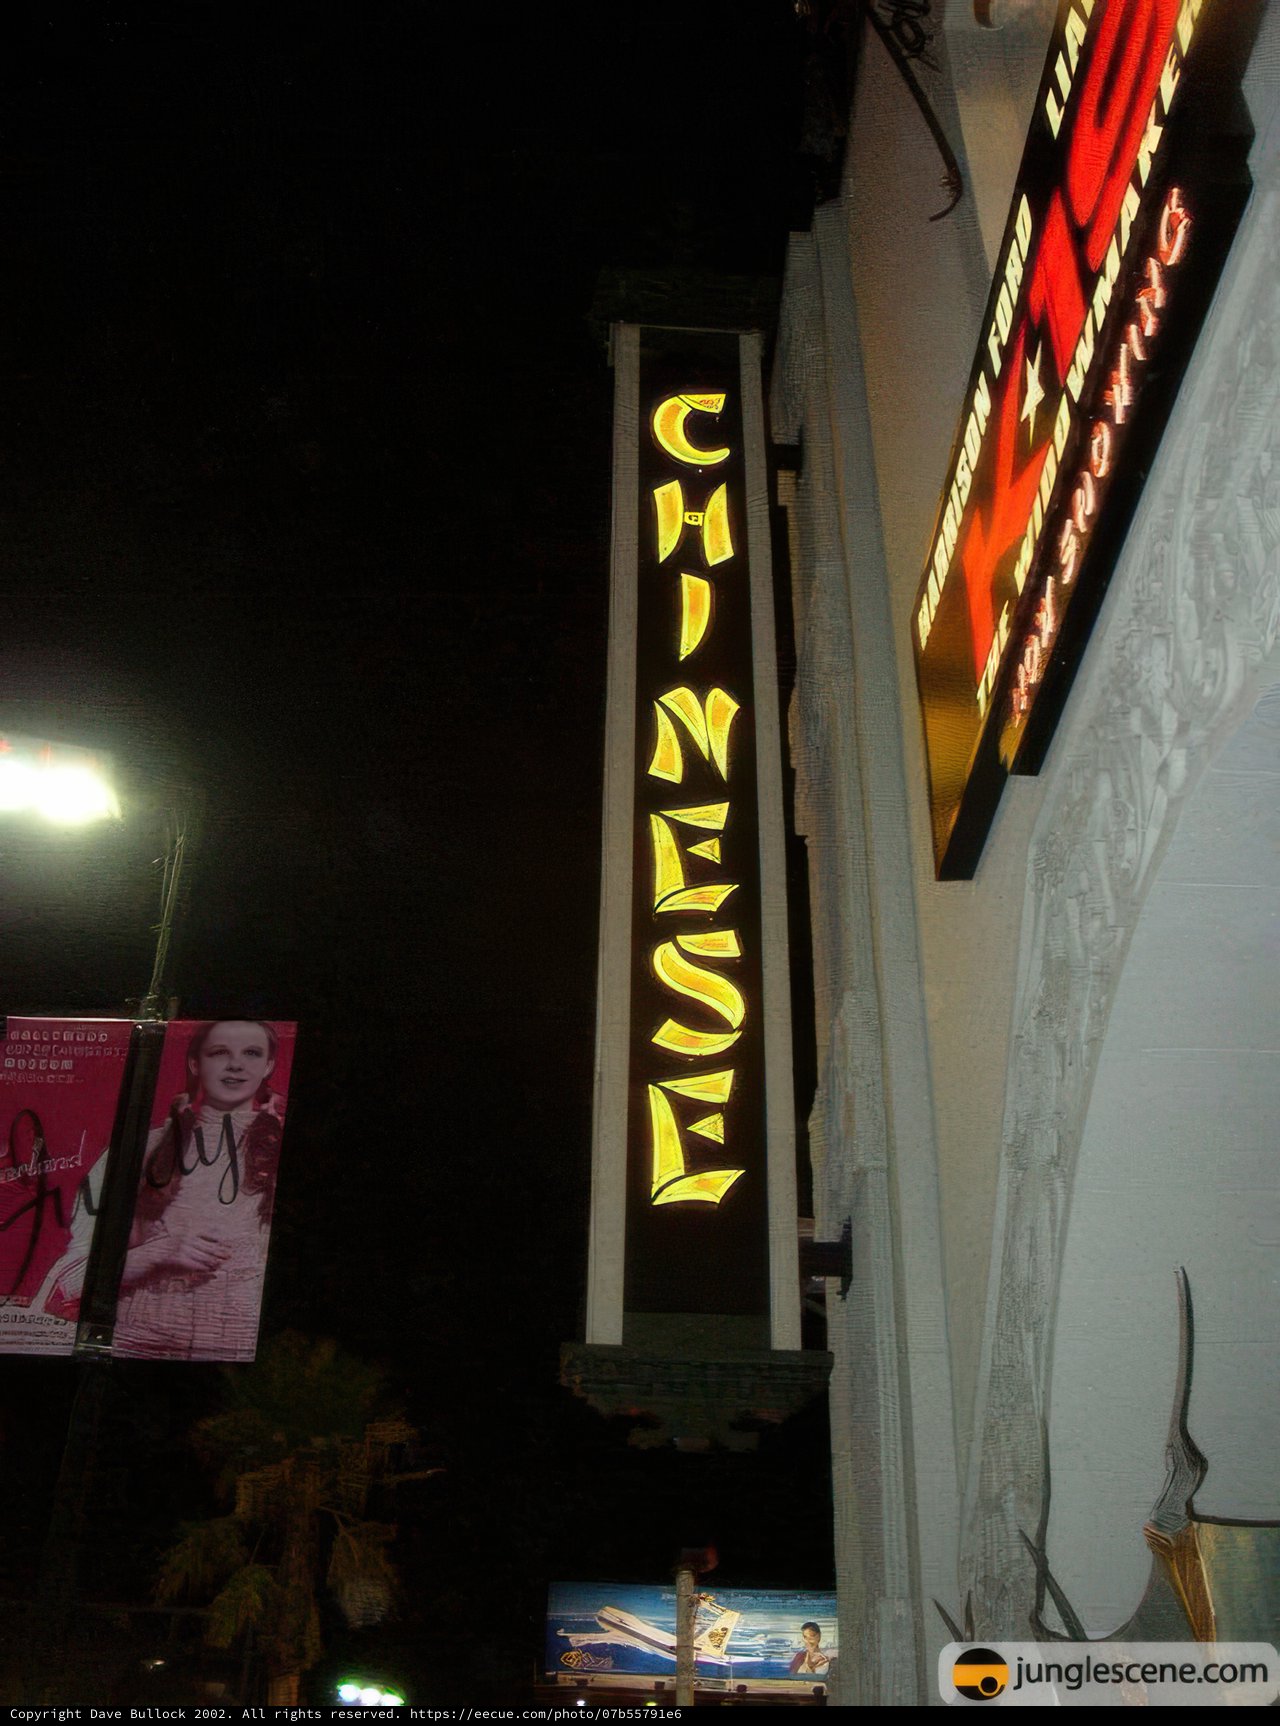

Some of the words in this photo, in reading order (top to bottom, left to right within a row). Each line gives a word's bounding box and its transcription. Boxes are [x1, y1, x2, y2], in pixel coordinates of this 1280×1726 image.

[918, 370, 992, 652] HARRISON
[987, 192, 1033, 379] FORD
[1045, 0, 1095, 140] LIA
[1060, 187, 1192, 585] SHOWING
[647, 392, 748, 1206] CHINESE
[976, 600, 1010, 722] THE
